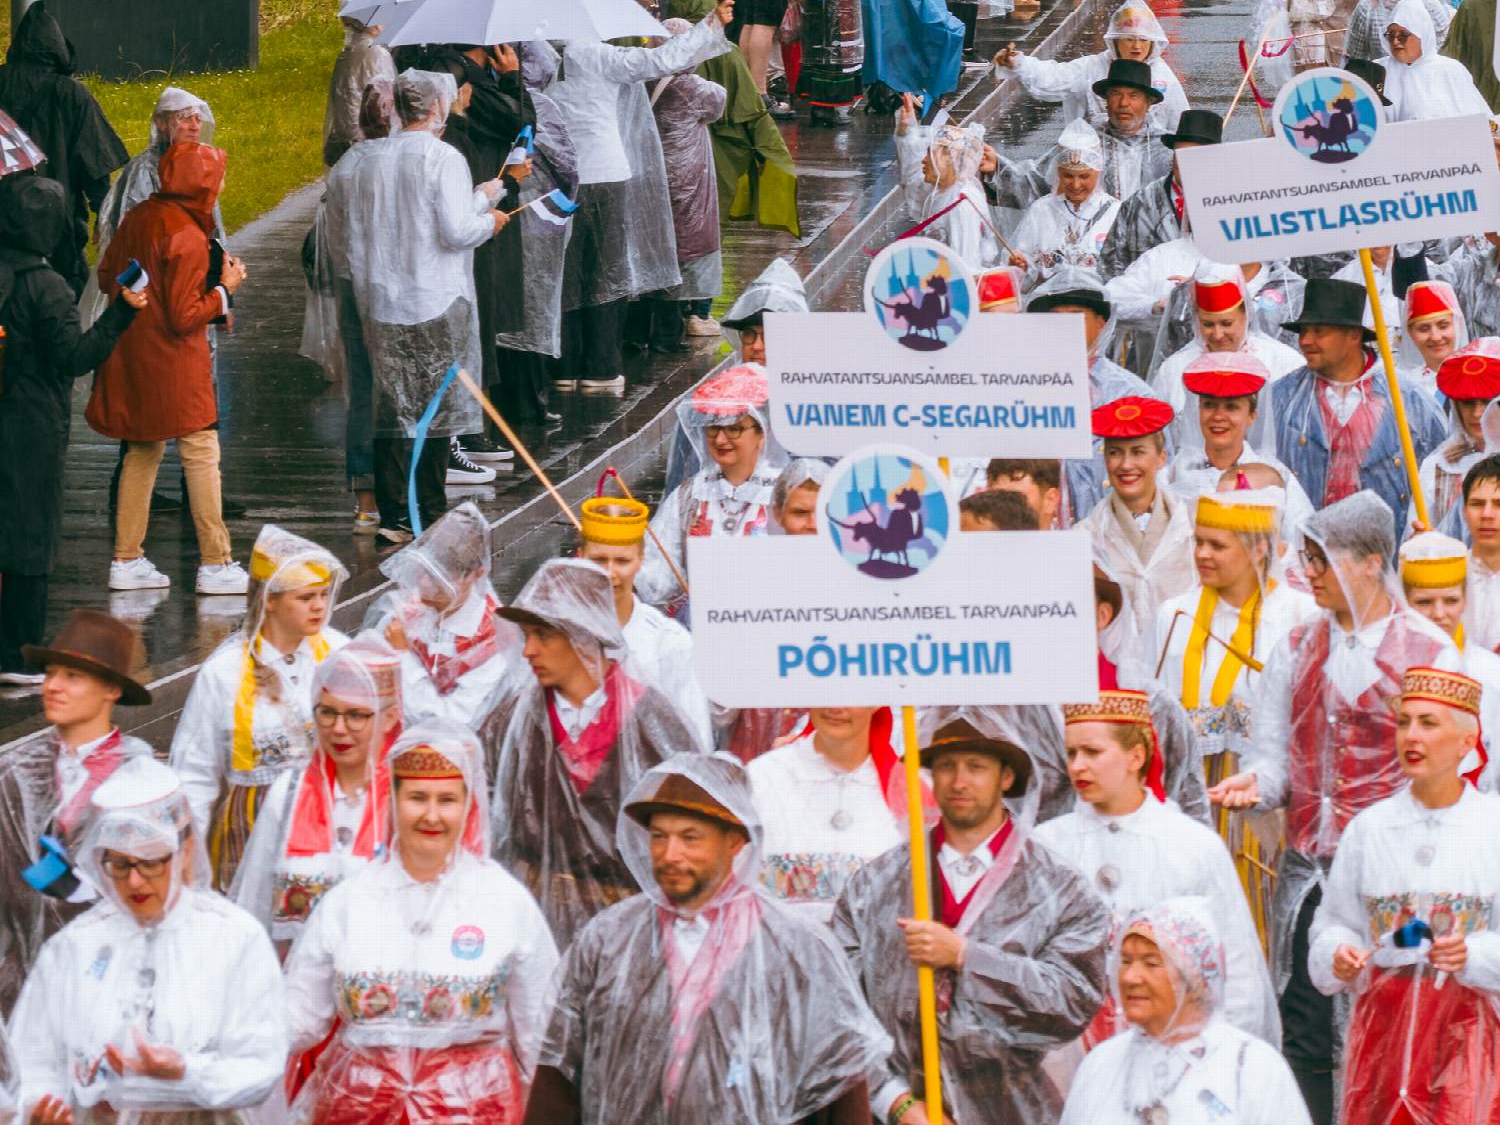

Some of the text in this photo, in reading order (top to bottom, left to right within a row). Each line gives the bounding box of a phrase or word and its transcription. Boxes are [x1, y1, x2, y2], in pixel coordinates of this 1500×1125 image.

[1201, 162, 1482, 209] RAHVATANTSUANSAMBEL TARVANPÄÄ
[1219, 188, 1478, 242] VILISTLASRÜHM
[780, 371, 1074, 387] RAHVATANTSUANSAMBEL TARVANPÄÄ
[784, 399, 1077, 429] VANEM C-SEGARÜHM
[706, 600, 1078, 624] RAHVATANTSUANSAMBEL TARVANPÄÄ
[777, 633, 1013, 679] PÕHIRÜHM
